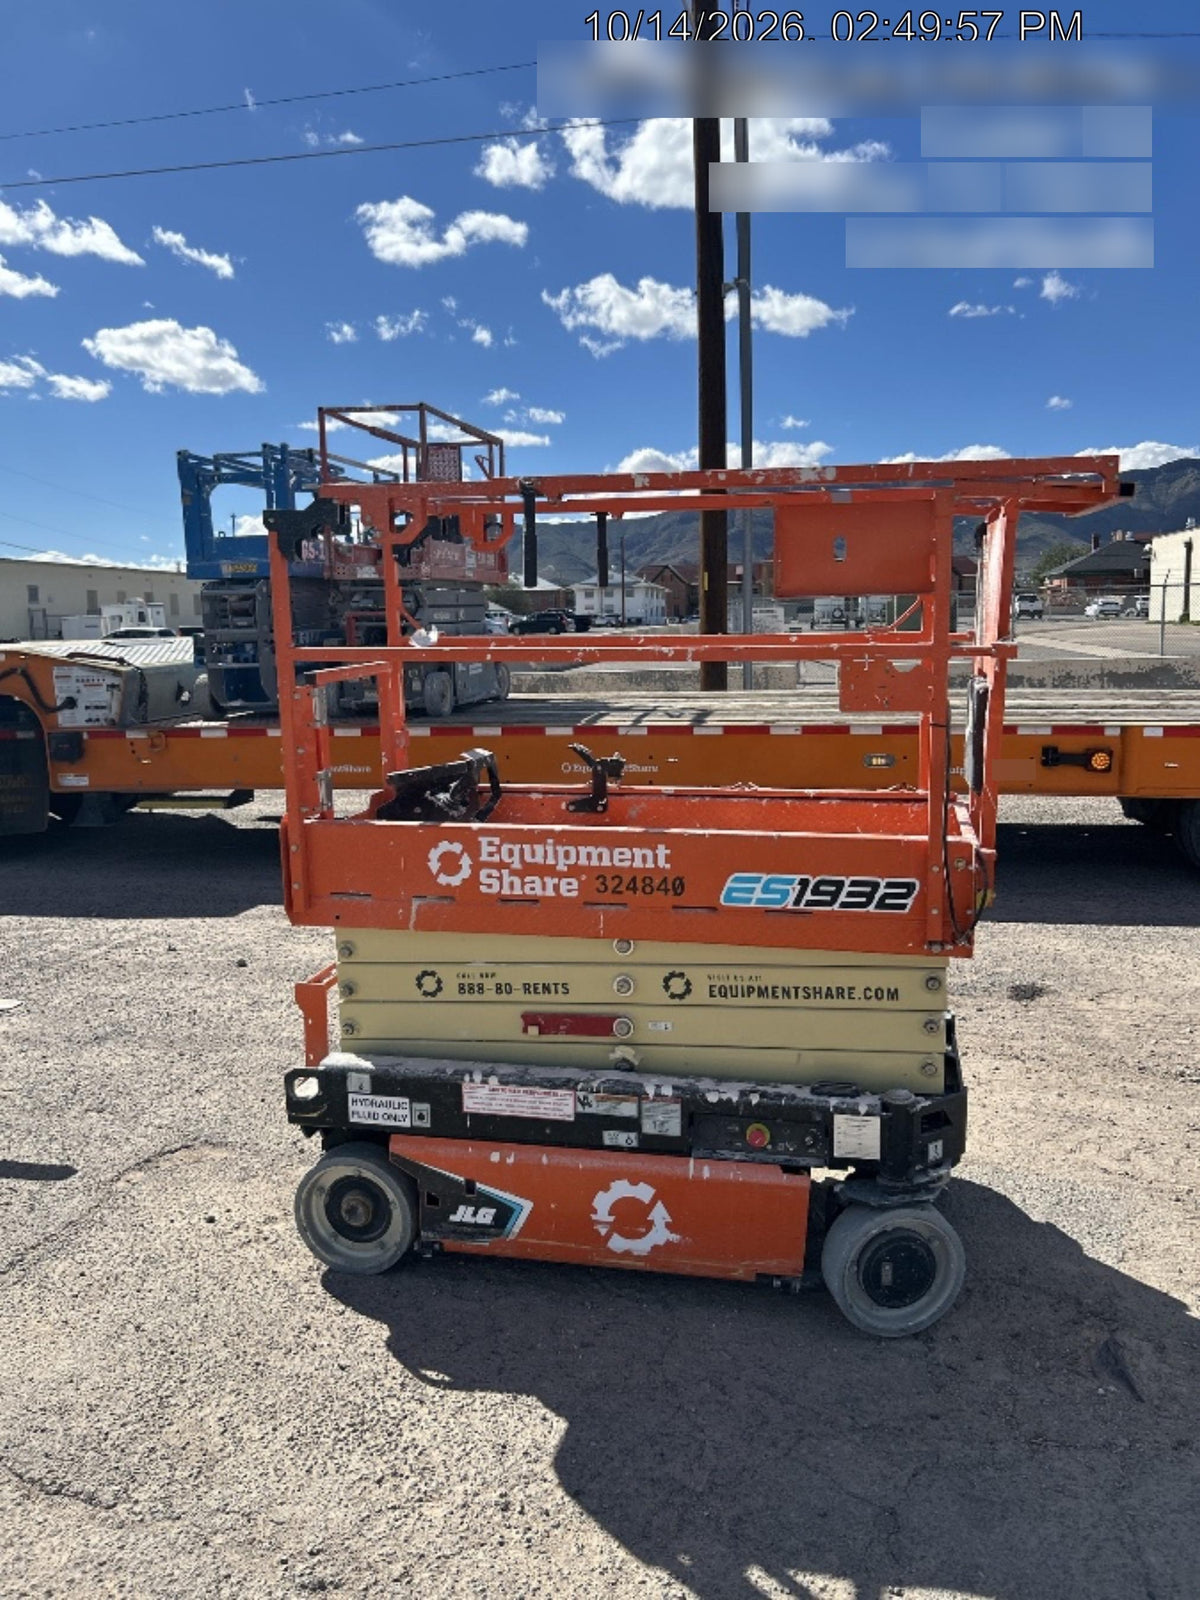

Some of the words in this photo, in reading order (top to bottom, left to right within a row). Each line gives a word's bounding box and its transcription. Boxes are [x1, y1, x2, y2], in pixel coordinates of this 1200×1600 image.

[478, 836, 671, 872] Equipment
[479, 868, 579, 897] Share
[595, 874, 685, 897] 324840
[720, 872, 920, 914] ES1932
[458, 982, 570, 995] 888-80-RENTS
[708, 984, 899, 1001] EQUIPMENTSHARE.COM
[351, 1097, 408, 1110] HYDRAULIC
[382, 1112, 408, 1122] ONLY
[449, 1205, 497, 1224] JLG
